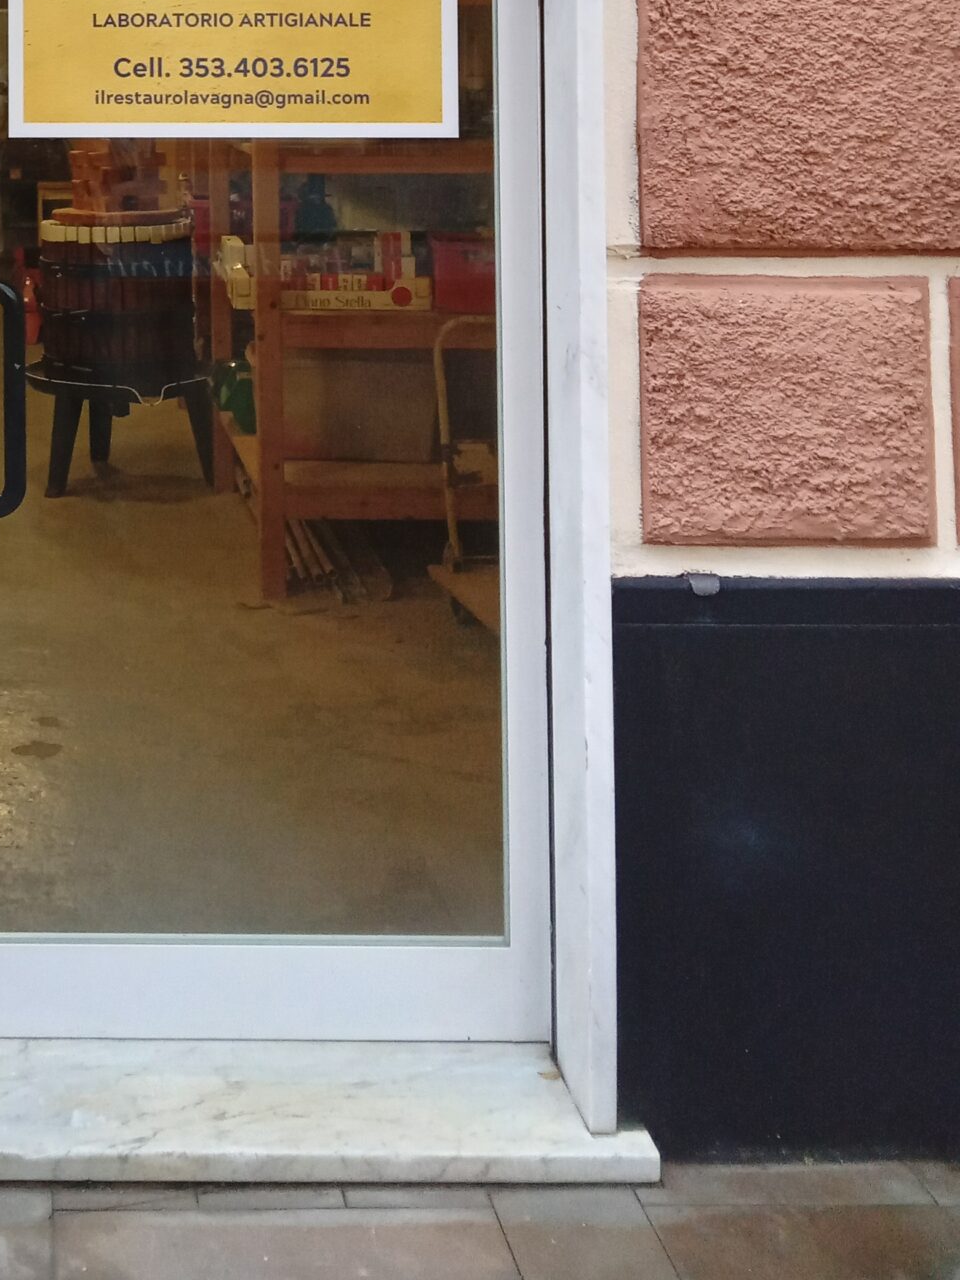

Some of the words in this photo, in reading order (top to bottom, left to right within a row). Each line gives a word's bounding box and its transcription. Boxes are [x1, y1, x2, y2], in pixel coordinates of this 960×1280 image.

[92, 13, 234, 28] LABORATORIO
[239, 12, 372, 28] ARTIGIANALE
[113, 57, 171, 78] Cell.
[179, 56, 351, 78] 353.403.6125
[94, 89, 371, 109] ilrestaurolavagna@gmail.com
